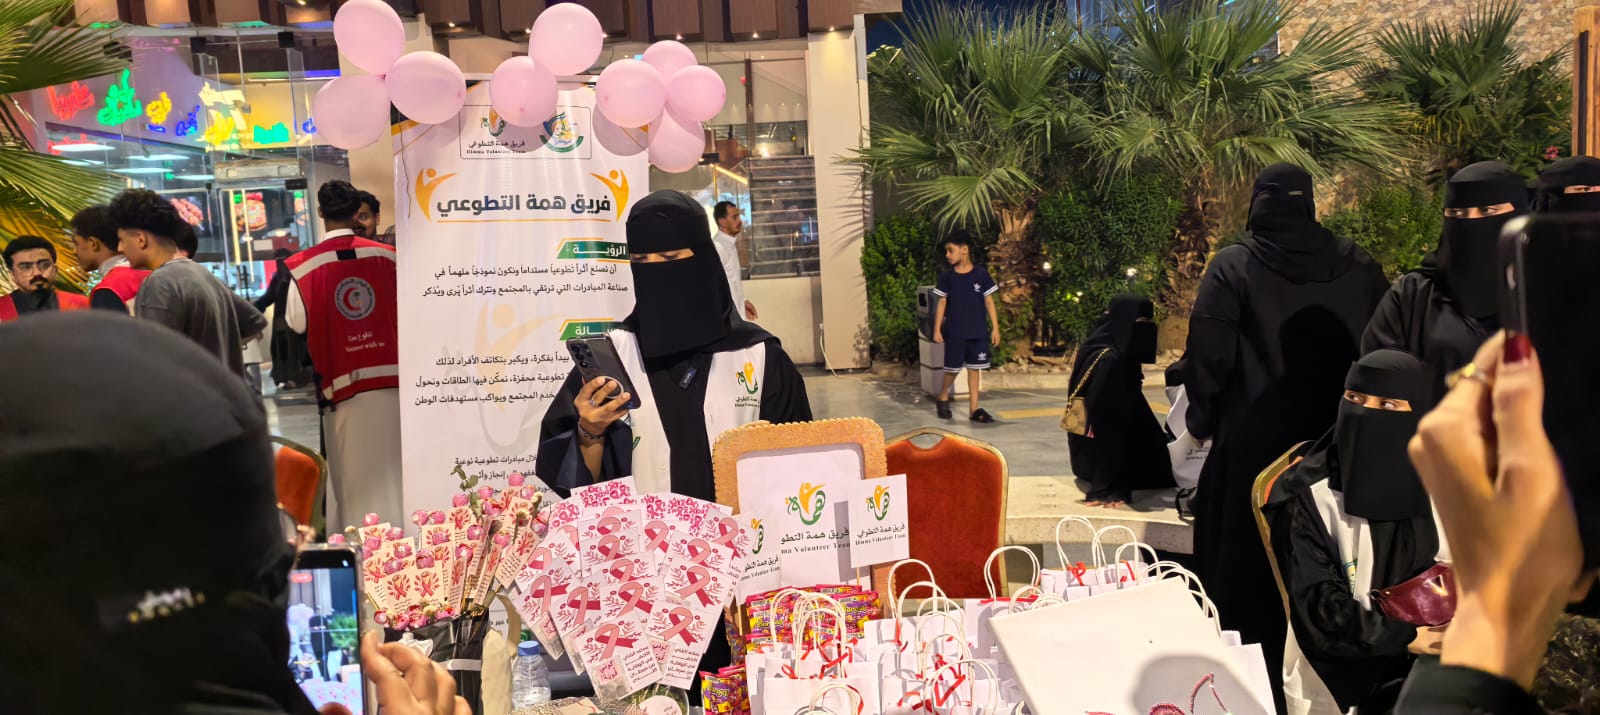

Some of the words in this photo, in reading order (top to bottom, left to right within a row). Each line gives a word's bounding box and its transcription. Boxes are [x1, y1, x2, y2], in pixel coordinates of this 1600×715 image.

[437, 194, 520, 217] التطوعي
[526, 195, 567, 212] همة
[571, 195, 611, 214] فريق
[434, 267, 445, 280] في
[497, 266, 519, 276] ونكون
[590, 265, 608, 275] نصنع
[476, 285, 496, 295] ونترك
[498, 284, 531, 296] بالمجتمع
[533, 284, 554, 296] ترتقي
[556, 284, 570, 295] التي
[573, 282, 605, 292] المبادرات
[608, 282, 628, 292] صناعة
[436, 357, 455, 365] لذلك
[457, 354, 479, 366] الأفراد
[508, 355, 528, 365] ويكبر
[556, 351, 569, 363] يبدأ
[442, 376, 470, 385] الطاقات
[473, 375, 487, 385] فيها
[537, 373, 564, 383] تطوعية
[415, 395, 437, 406] الوطن
[439, 394, 478, 404] مستهدفات
[480, 393, 507, 403] ويواكب
[509, 391, 537, 403] المجتمع
[540, 391, 556, 401] خدم
[475, 456, 498, 466] تطوعية
[500, 455, 524, 464] مبادرات
[780, 532, 803, 544] التطو
[806, 531, 825, 540] همة
[829, 527, 849, 539] فريق
[744, 561, 756, 573] التطو
